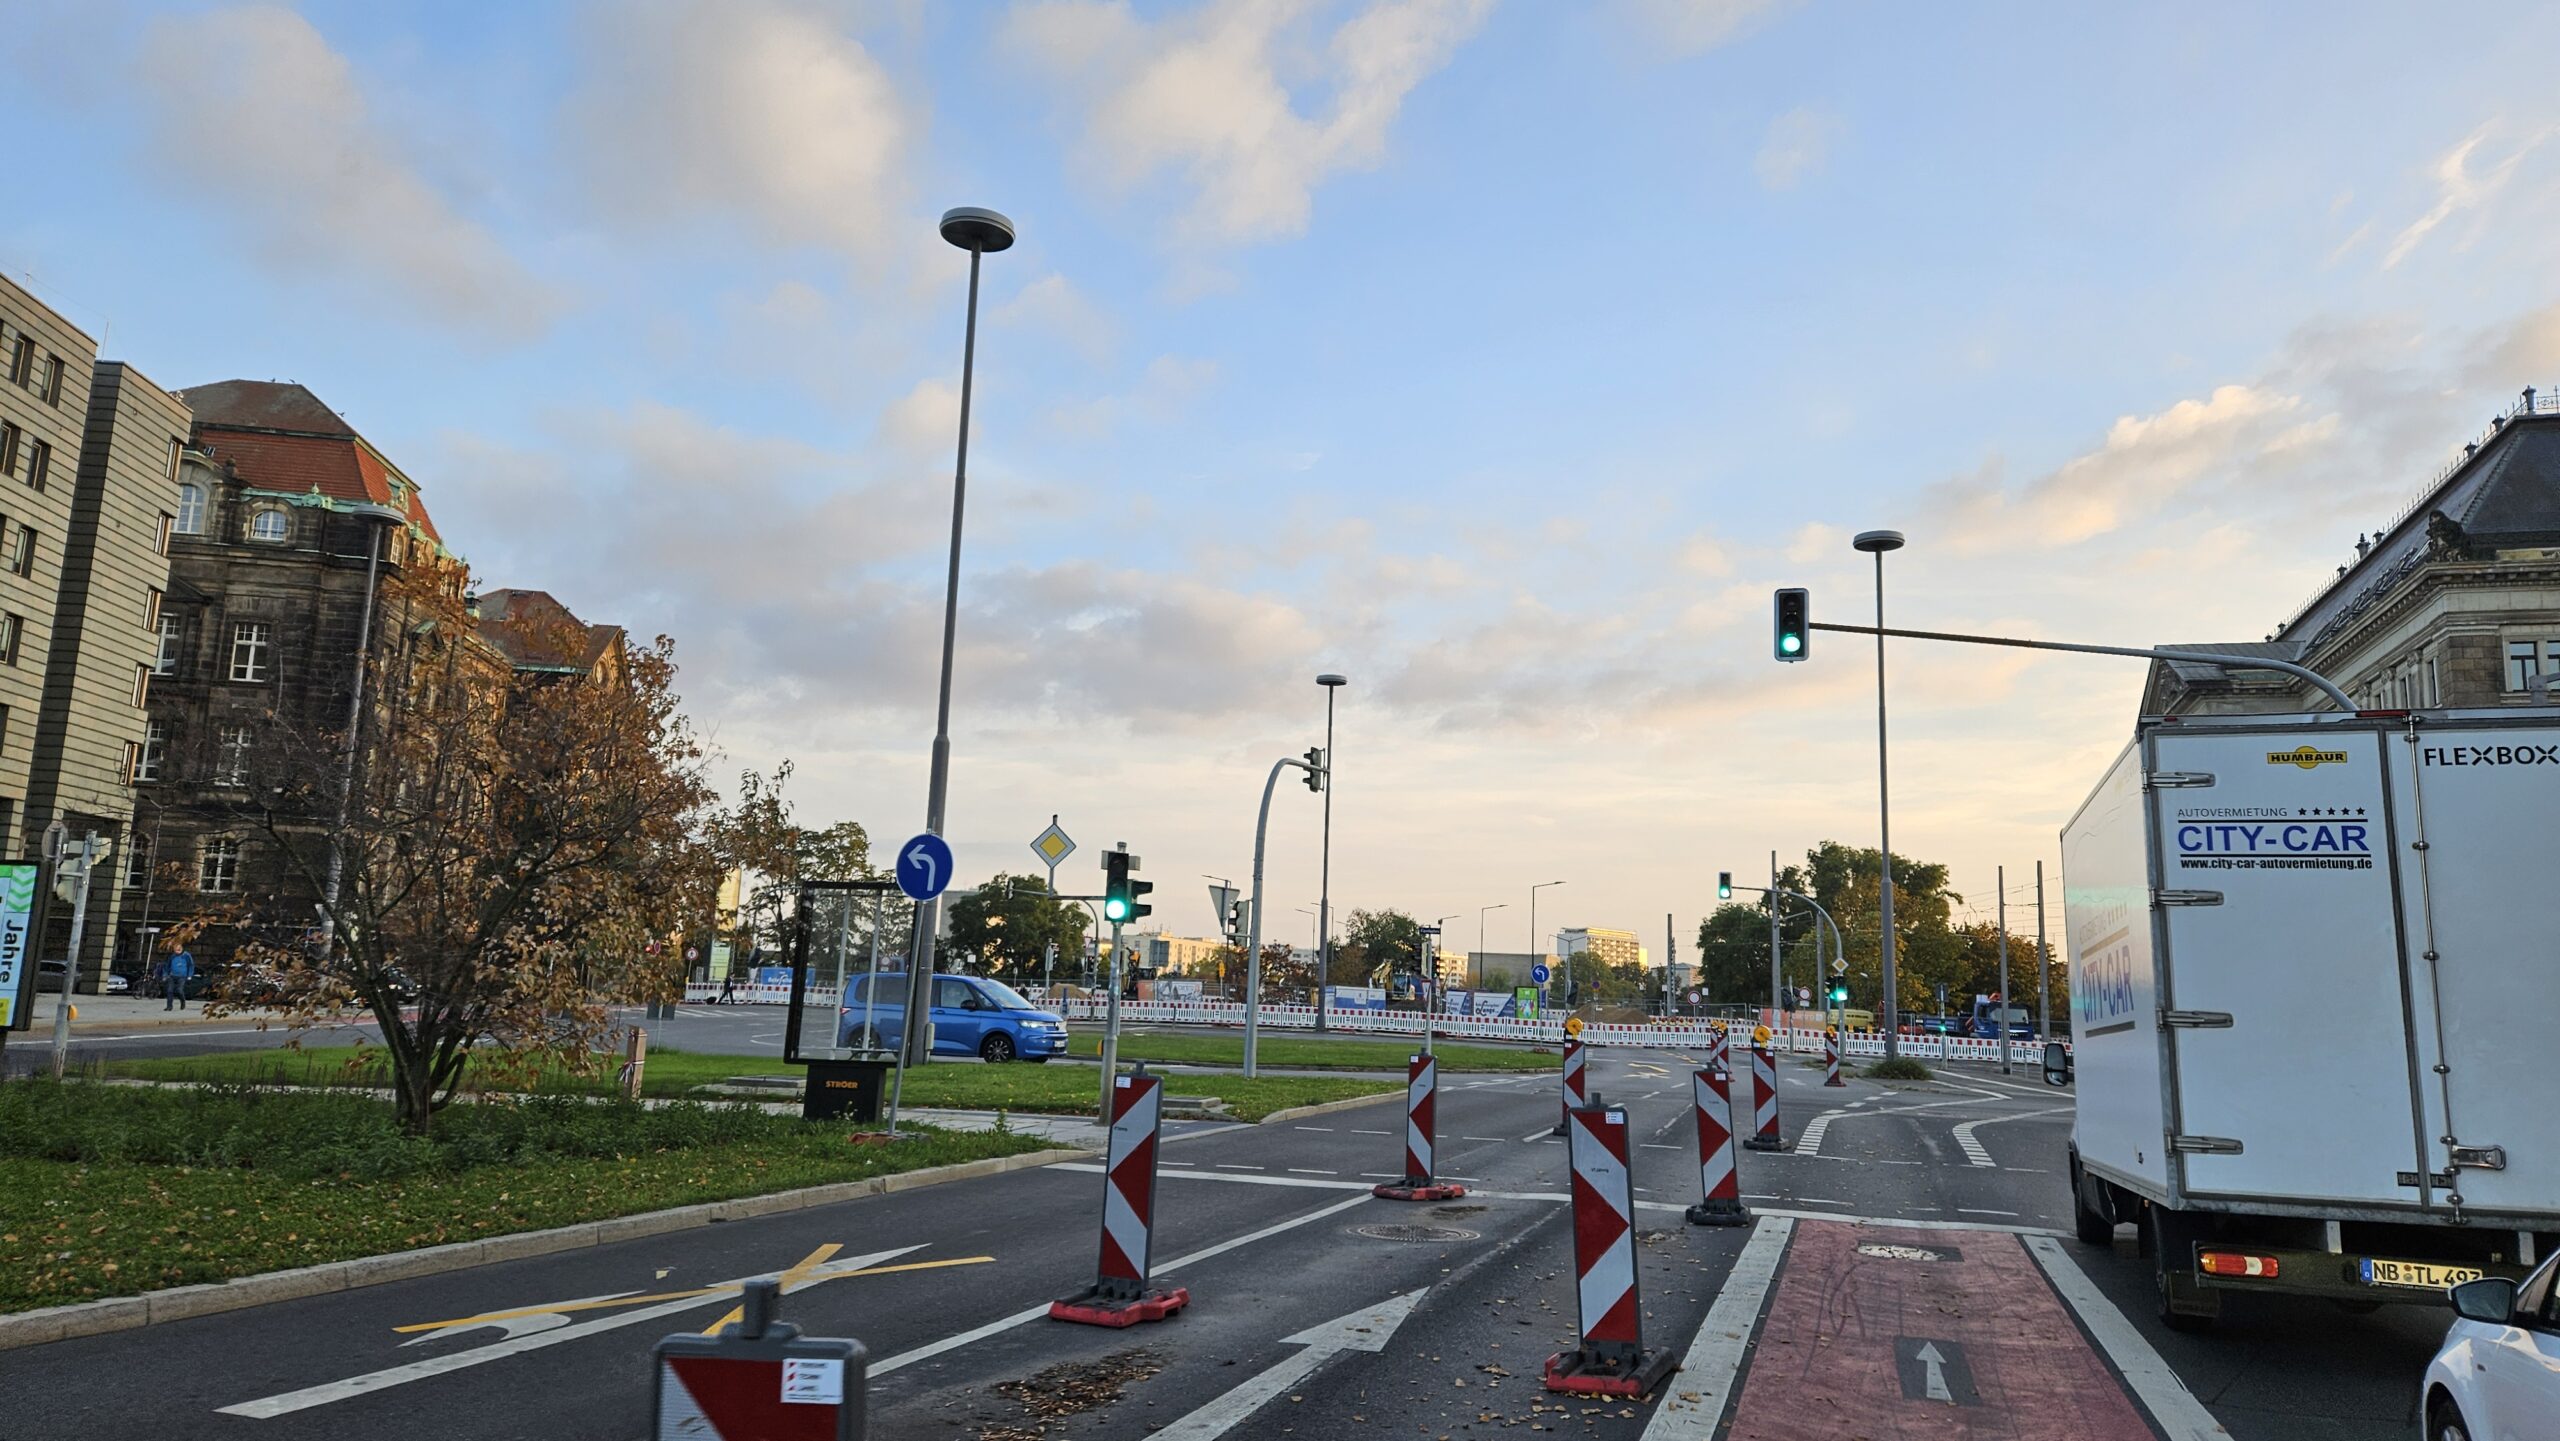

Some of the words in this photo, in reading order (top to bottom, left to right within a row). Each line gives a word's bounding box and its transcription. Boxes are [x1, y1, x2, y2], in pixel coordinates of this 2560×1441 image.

[2271, 753, 2345, 762] HUMBAUR
[2424, 745, 2560, 766] FLEXBOX
[2178, 807, 2288, 818] AUTOVERMIETUNG
[2178, 825, 2370, 851] CITY-CAR
[2181, 857, 2373, 871] www.city-car-autovermietung.de
[0, 919, 23, 983] Jahre
[2082, 945, 2134, 1024] CITY-CAR
[2373, 1262, 2399, 1281] NB
[2413, 1266, 2440, 1285] TL
